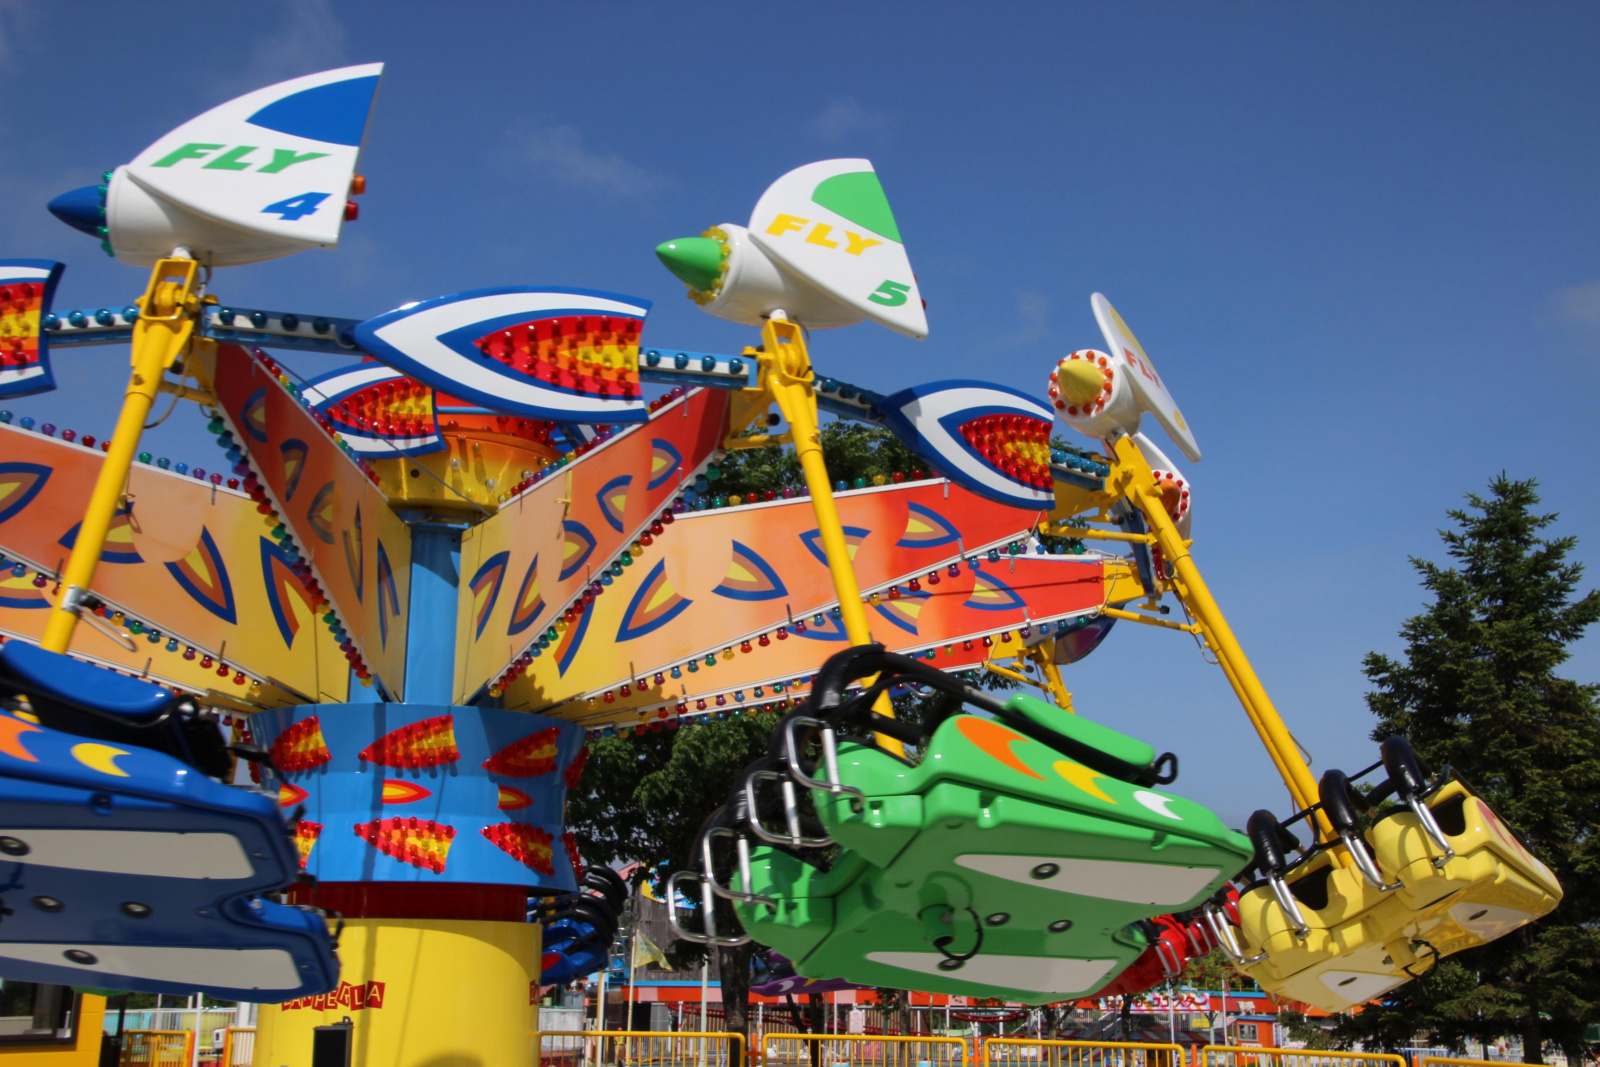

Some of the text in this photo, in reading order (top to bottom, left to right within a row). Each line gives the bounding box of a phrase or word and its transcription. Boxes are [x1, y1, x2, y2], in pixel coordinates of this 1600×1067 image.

[149, 142, 332, 174] FLY
[259, 191, 332, 221] 4
[765, 213, 885, 256] FLY
[867, 279, 911, 307] 5
[1123, 347, 1161, 389] FLY
